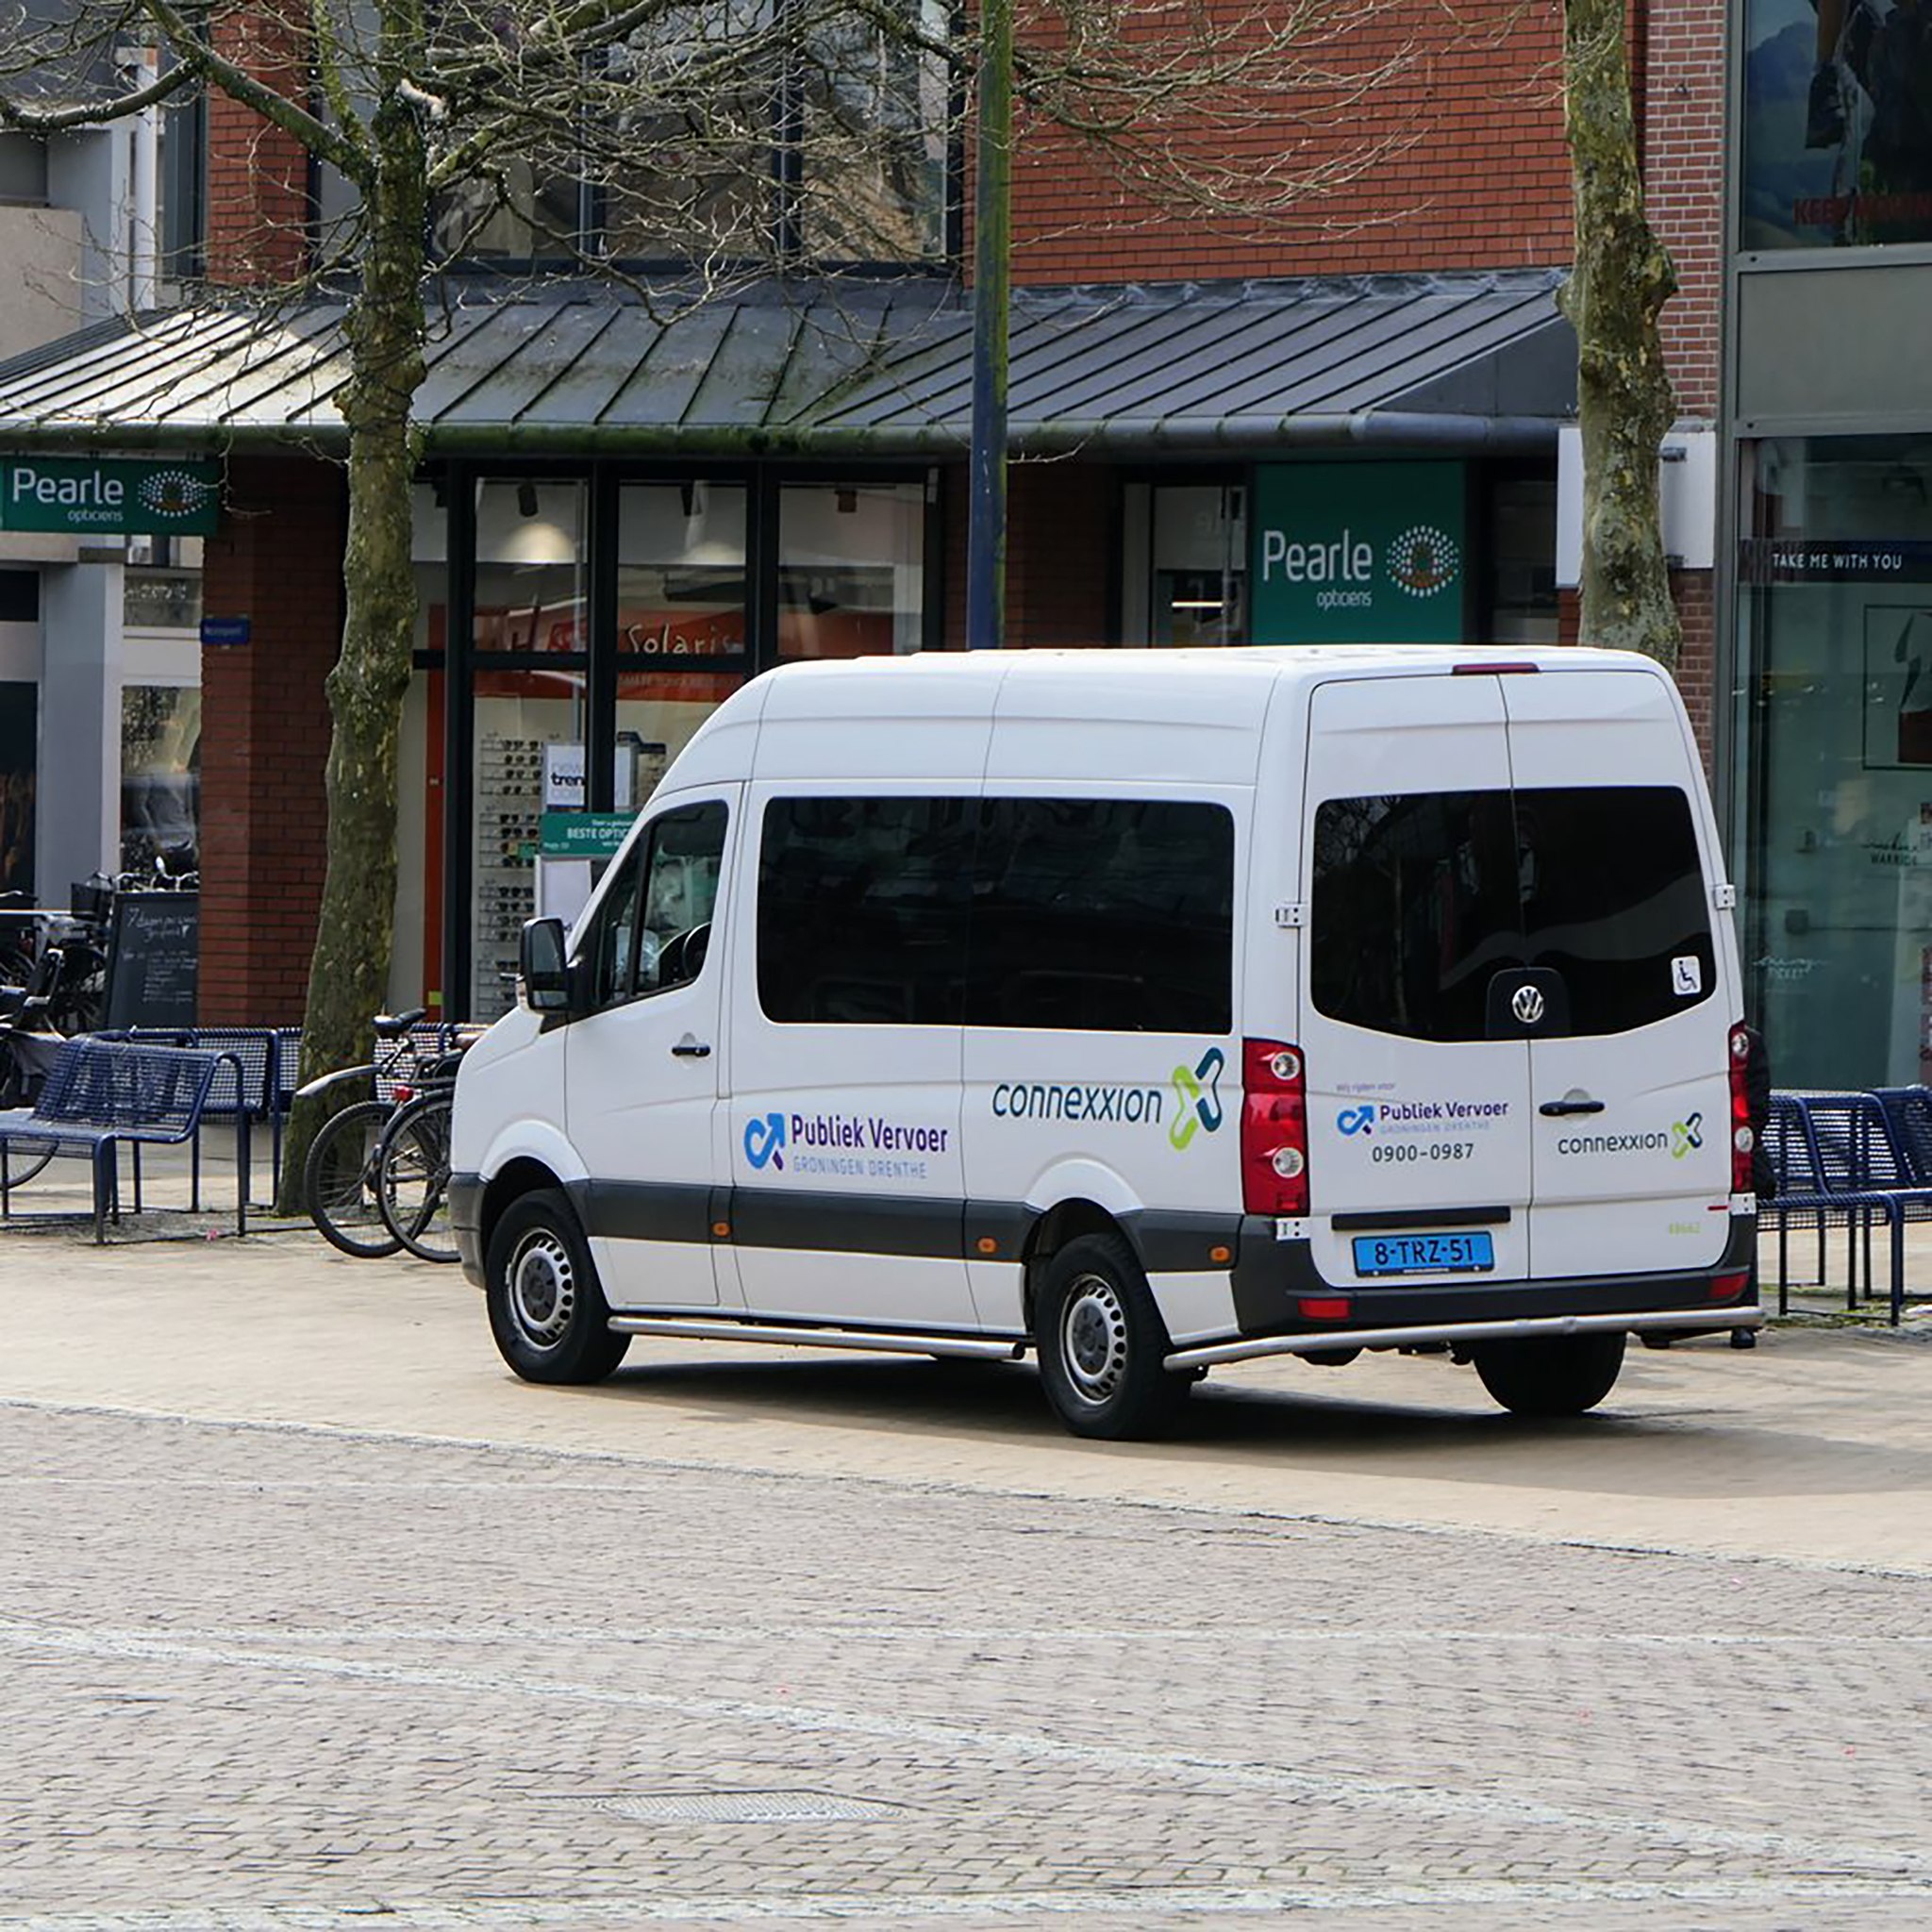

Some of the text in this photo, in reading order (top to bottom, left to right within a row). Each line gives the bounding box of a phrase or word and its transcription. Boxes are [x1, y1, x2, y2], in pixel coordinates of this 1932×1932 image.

[12, 468, 124, 506] Pearle
[1262, 528, 1373, 582] Pearle
[1772, 554, 1903, 570] TAKE ME WITH YOU
[567, 827, 597, 840] BESTE
[992, 1082, 1162, 1124] connexxion
[1380, 1102, 1508, 1121] Publiek Vervoer
[791, 1114, 948, 1152] Publiek Vervoer
[1557, 1131, 1668, 1156] connexxion
[1372, 1142, 1474, 1162] 0900-0987
[792, 1156, 927, 1179] GRONINGEN DRENTHE
[1374, 1239, 1474, 1265] 8-TRZ-51
